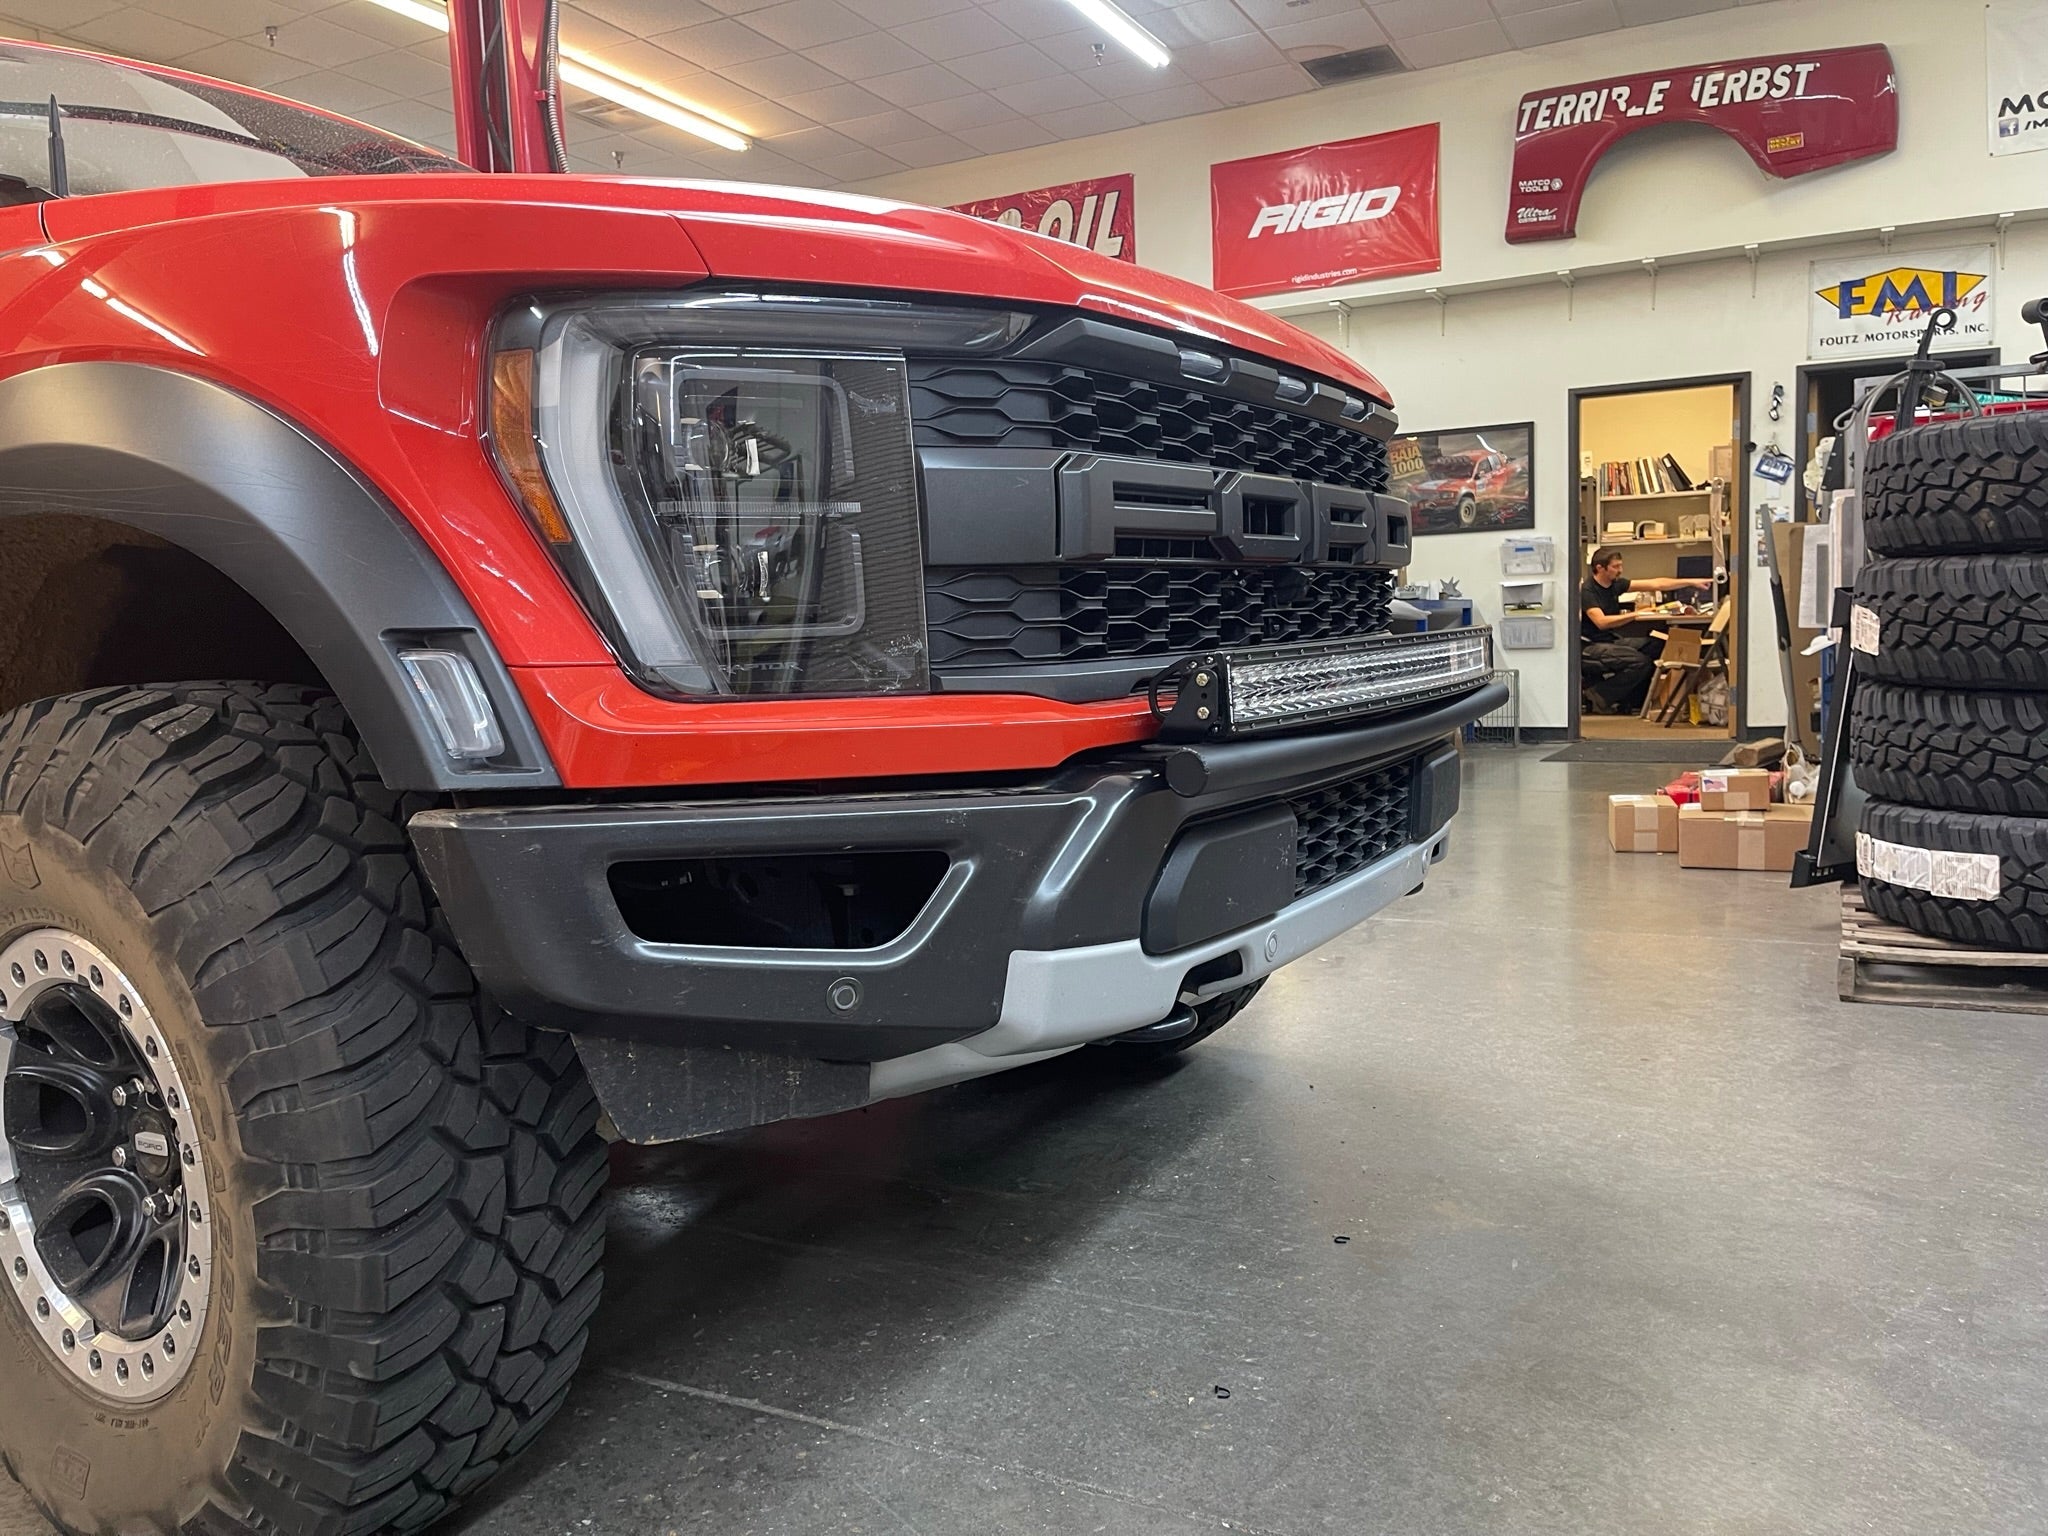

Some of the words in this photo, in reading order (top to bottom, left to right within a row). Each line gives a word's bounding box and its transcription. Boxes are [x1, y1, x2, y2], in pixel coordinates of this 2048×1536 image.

[1519, 179, 1550, 187] MATCO
[1247, 185, 1402, 239] RIGID
[1037, 190, 1125, 258] OIL
[1291, 267, 1358, 284] rigidindustries.com
[1838, 270, 1958, 320] FMI
[1819, 336, 1859, 347] FOUTZ
[1964, 323, 1989, 334] INC.
[1389, 446, 1420, 464] BAJA
[1392, 457, 1424, 476] 1000
[1061, 451, 1411, 569] FORD
[137, 1140, 163, 1152] FORD
